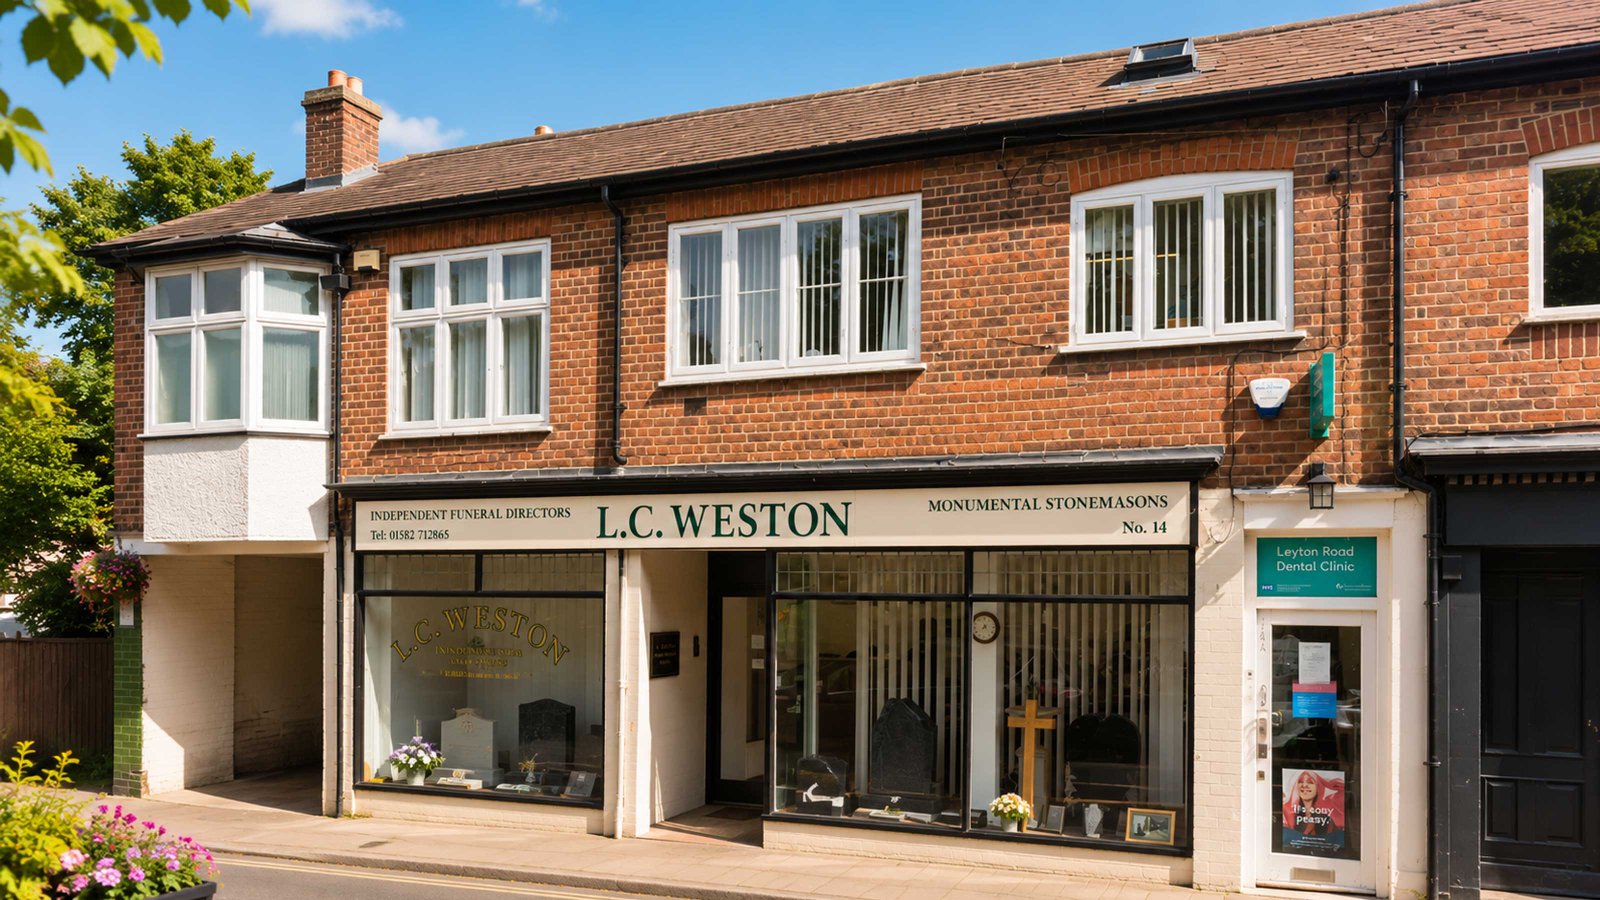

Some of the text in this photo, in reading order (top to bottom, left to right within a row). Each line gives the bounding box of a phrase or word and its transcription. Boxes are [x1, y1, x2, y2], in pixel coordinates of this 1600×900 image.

[928, 494, 1168, 512] MONUMENTAL STONEMASONS
[370, 507, 571, 521] INDEPENDENT FUNERAL DIRECTORS
[596, 501, 853, 539] L.C. WESTON
[1122, 520, 1167, 534] No. 14
[370, 529, 450, 541] Tel: 01582 712865
[1276, 545, 1354, 560] Leyton Road
[1276, 560, 1355, 572] Dental Clinic
[442, 605, 570, 665] WESTON
